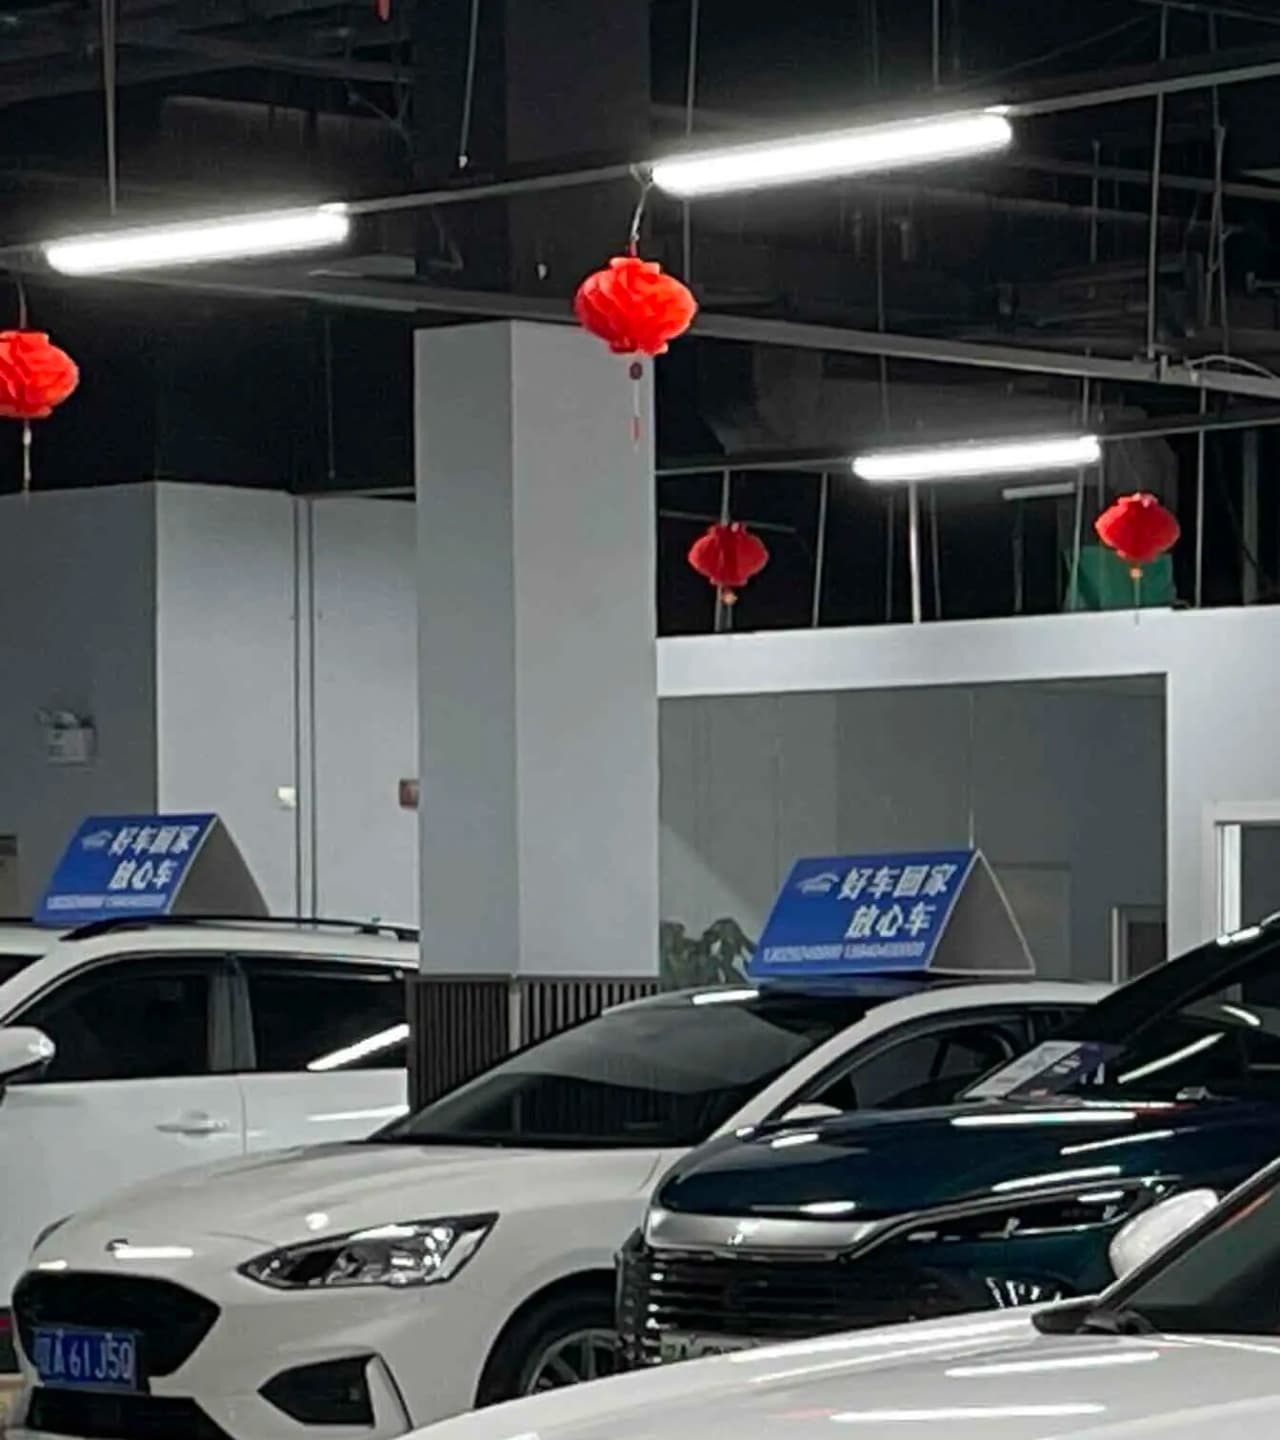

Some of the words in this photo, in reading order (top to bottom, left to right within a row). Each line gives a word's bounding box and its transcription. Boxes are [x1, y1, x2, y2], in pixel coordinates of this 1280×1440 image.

[836, 863, 957, 901] 好车回家
[843, 901, 936, 939] 放心车
